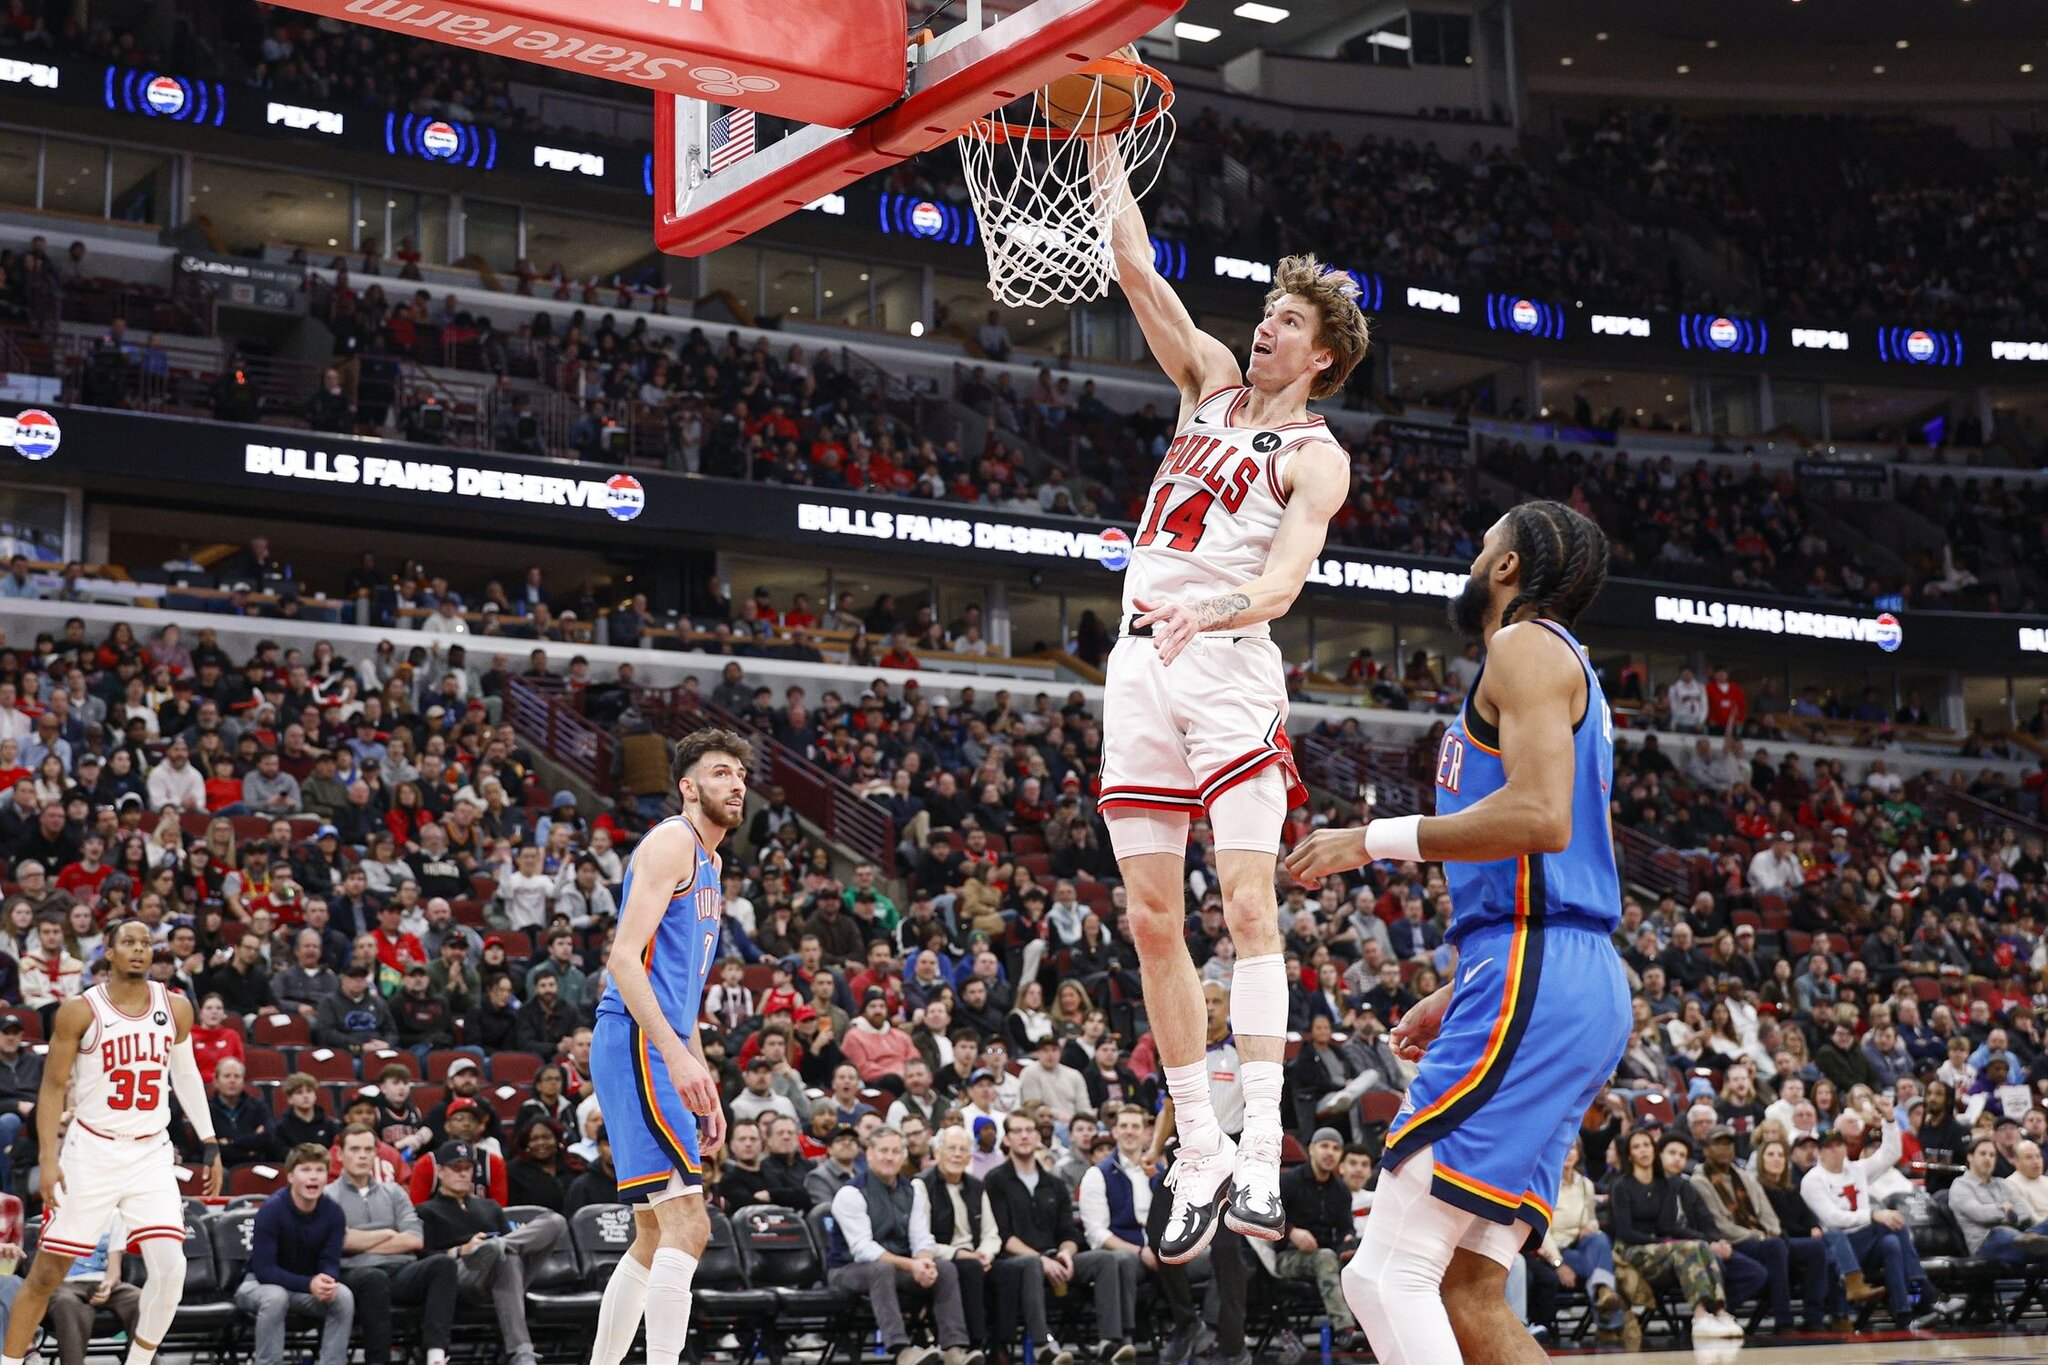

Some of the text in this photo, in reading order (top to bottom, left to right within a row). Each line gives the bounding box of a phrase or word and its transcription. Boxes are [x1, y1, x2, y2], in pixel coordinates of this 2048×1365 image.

[0, 57, 59, 89] EPSI
[267, 102, 344, 135] PEPSI
[534, 146, 604, 177] PEPSI
[1591, 314, 1650, 337] PEPSI
[246, 444, 608, 510] BULLS FANS DESERVE
[1154, 434, 1261, 515] BULLS
[797, 503, 895, 539] BULLS
[895, 513, 973, 547] FANS
[1135, 482, 1216, 553] 14
[1344, 561, 1411, 594] FANS
[1655, 596, 1727, 628] BULLS
[1727, 604, 1784, 634] FANS
[700, 930, 714, 977] 7
[101, 1032, 173, 1073] BULLS
[107, 1069, 162, 1111] 35
